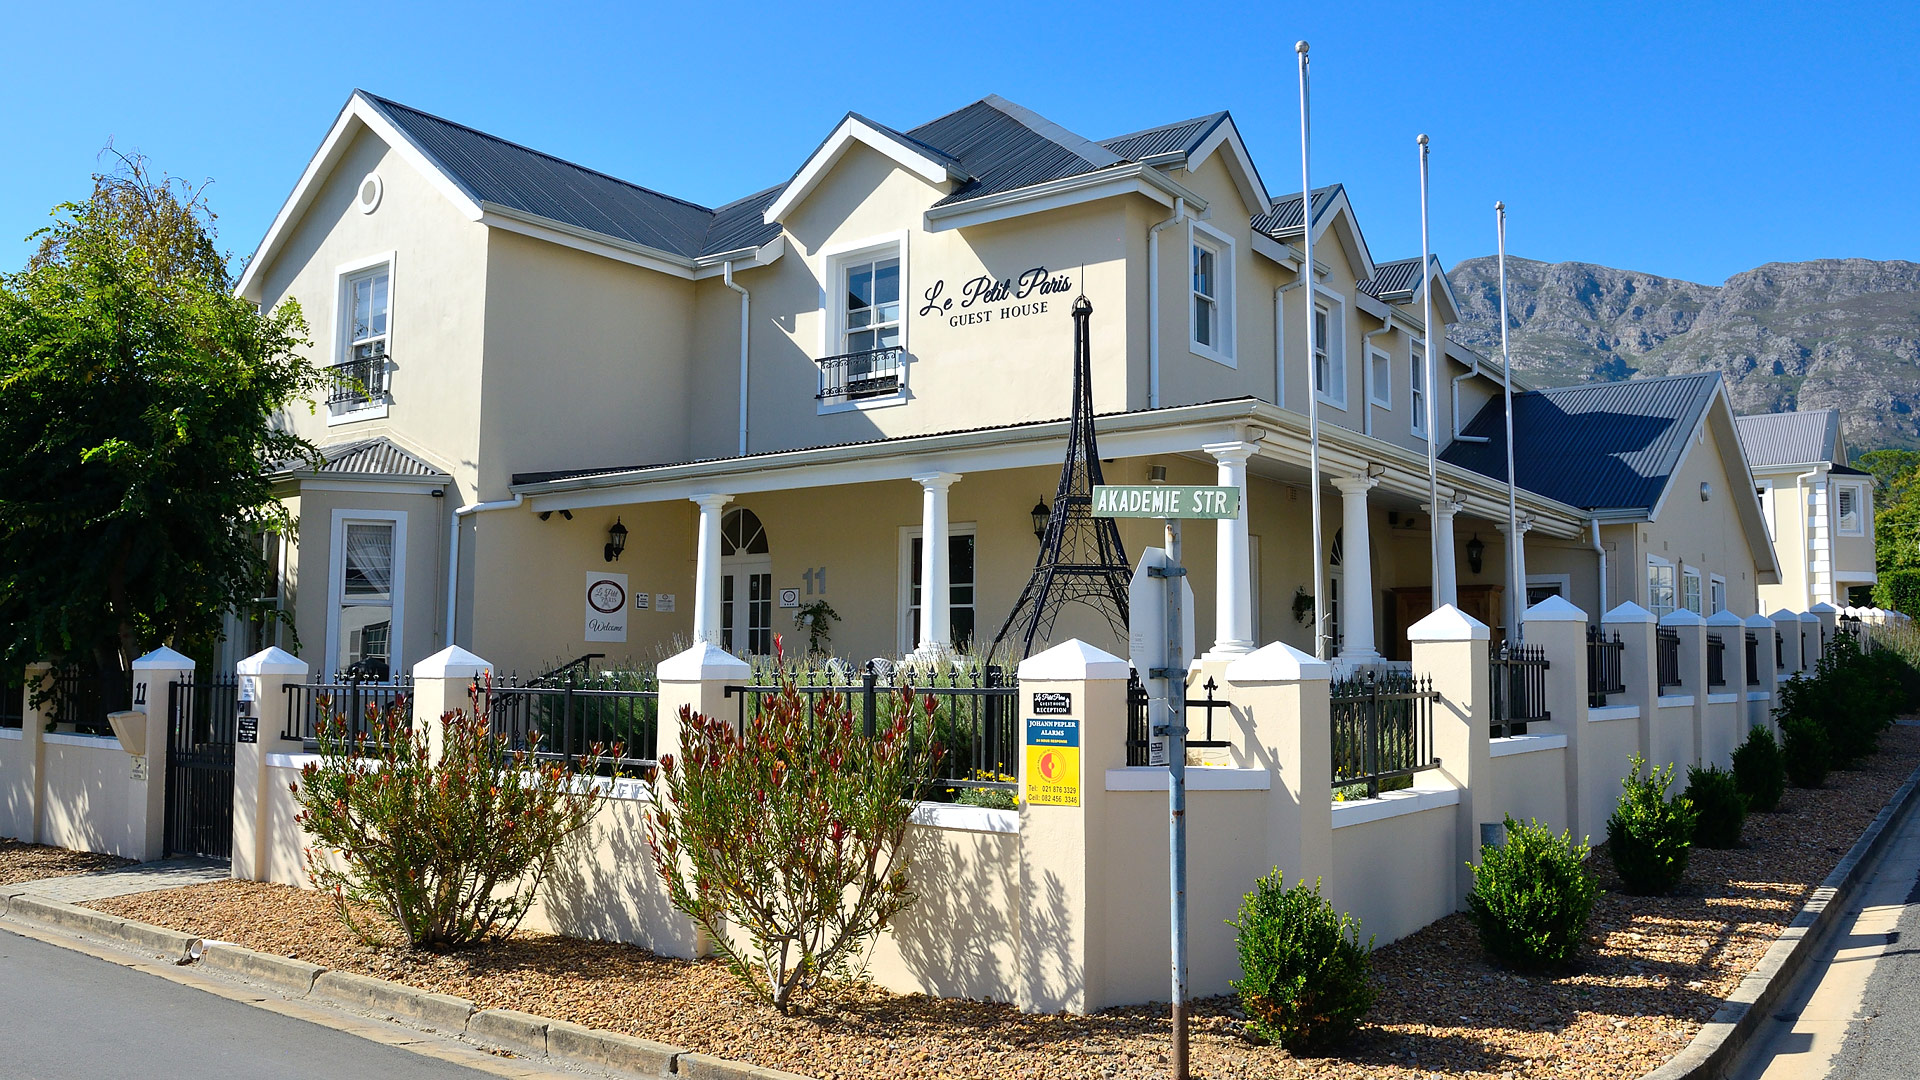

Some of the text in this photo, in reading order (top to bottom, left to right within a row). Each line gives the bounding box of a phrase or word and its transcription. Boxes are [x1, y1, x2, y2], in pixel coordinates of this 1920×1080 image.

[919, 265, 1072, 317] Le Petit Paris
[949, 302, 1048, 328] GUEST HOUSE
[1097, 489, 1231, 514] AKADEMIE STR.
[802, 566, 826, 595] 11
[588, 618, 623, 632] Welcome
[134, 682, 147, 705] 11
[1029, 720, 1053, 728] JOHANN
